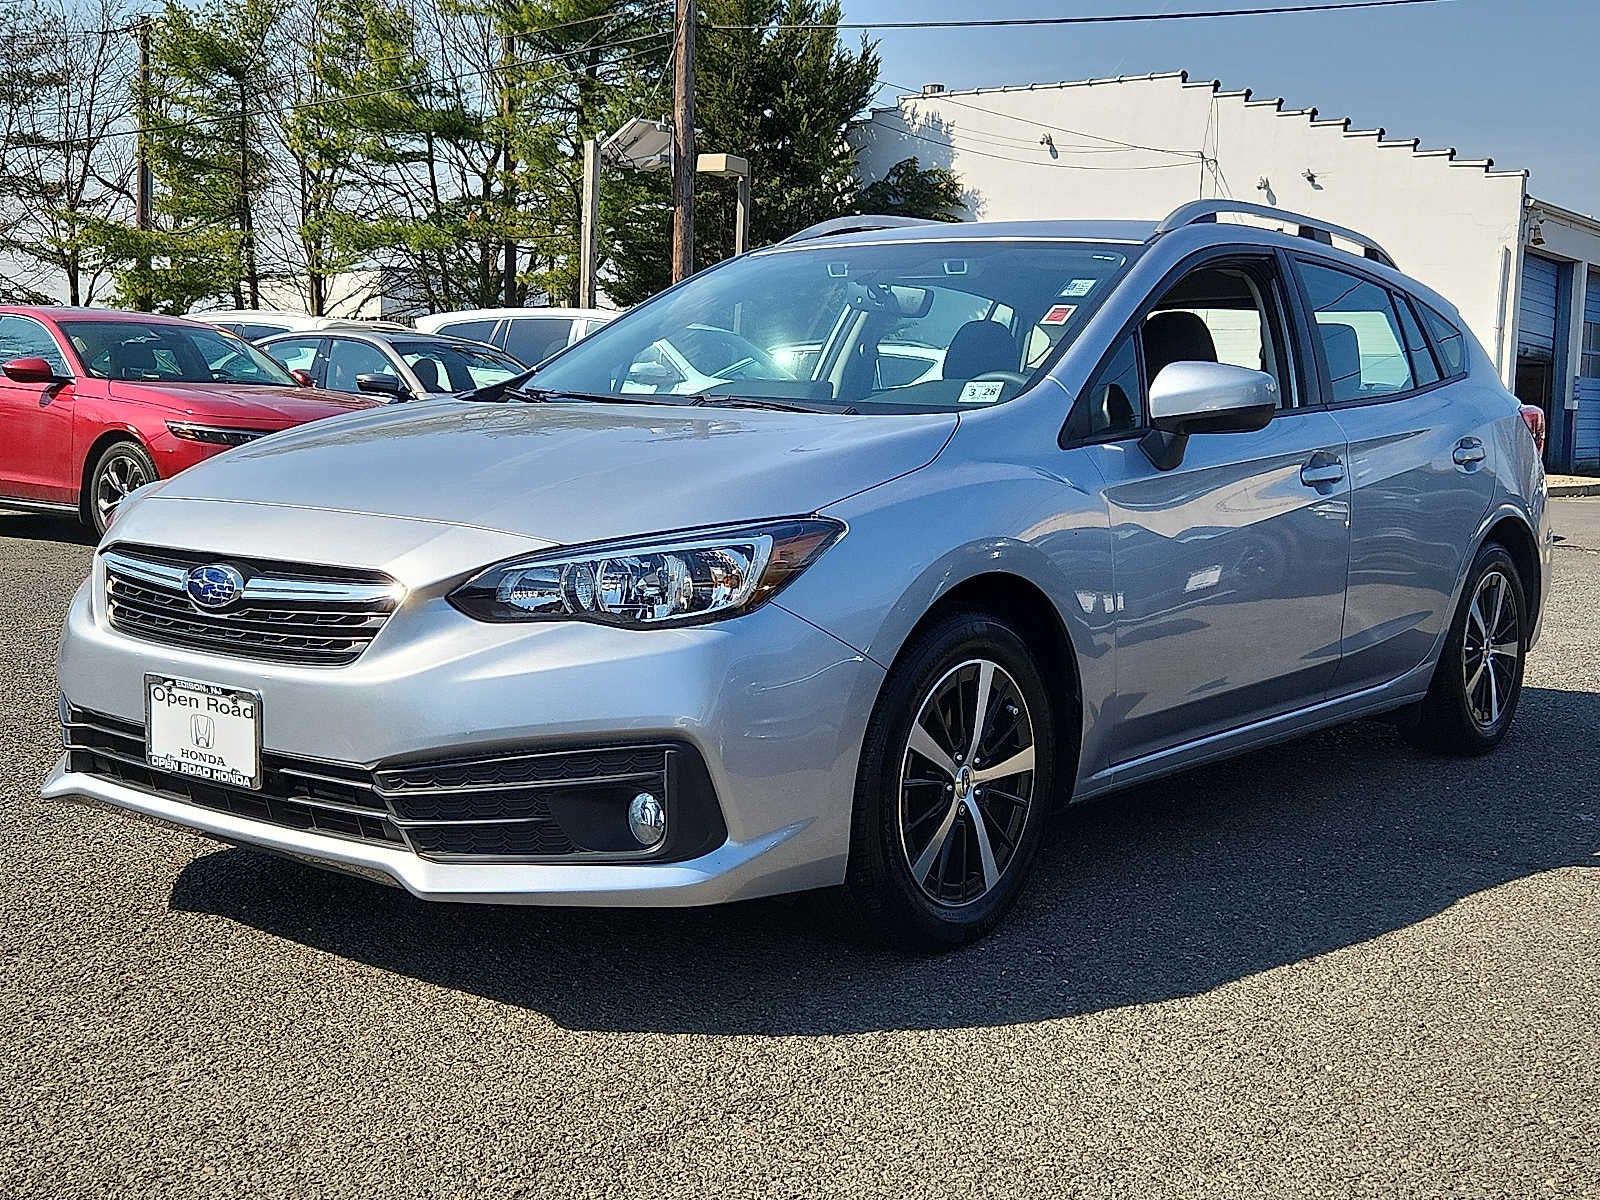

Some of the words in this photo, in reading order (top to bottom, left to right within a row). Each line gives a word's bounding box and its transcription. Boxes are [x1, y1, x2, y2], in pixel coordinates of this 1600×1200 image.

[968, 388, 976, 397] 3
[211, 686, 223, 695] NJ
[153, 686, 199, 708] Open
[207, 696, 254, 720] Road
[180, 748, 227, 767] HONDA
[151, 756, 179, 772] OPEN
[181, 762, 211, 778] ROAD
[212, 769, 251, 788] HONDA
